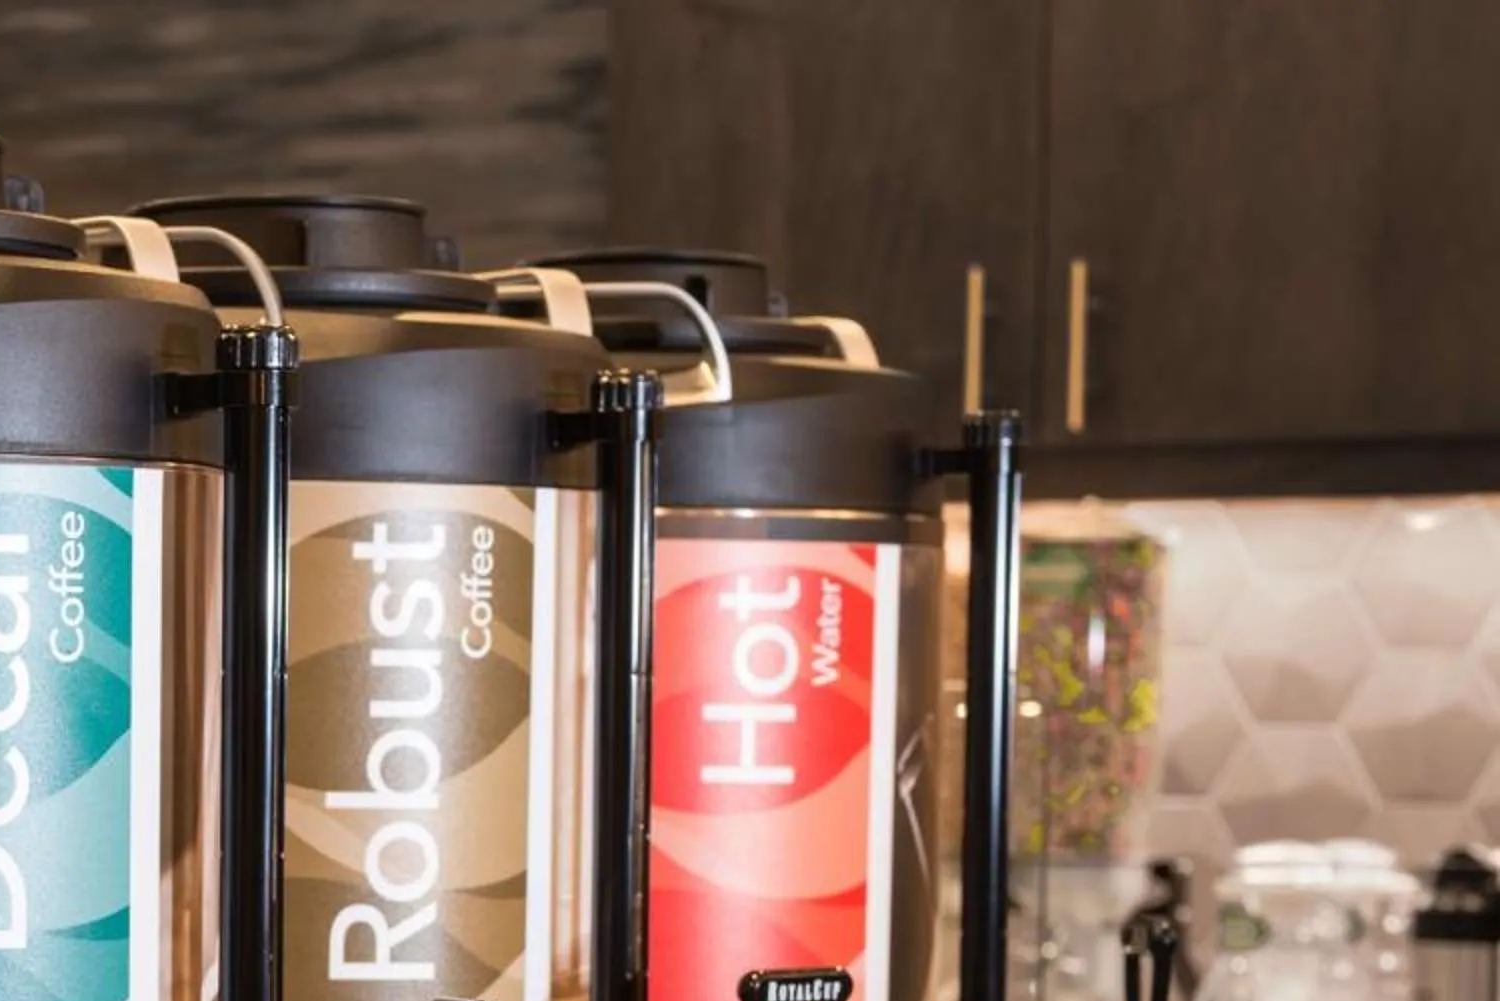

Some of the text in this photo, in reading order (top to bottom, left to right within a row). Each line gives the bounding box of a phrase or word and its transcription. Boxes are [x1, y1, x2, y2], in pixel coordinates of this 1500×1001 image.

[48, 510, 85, 664] Coffee
[461, 524, 496, 660] Coffee
[811, 579, 843, 687] Water
[324, 522, 447, 982] Robust
[700, 575, 801, 785] Hot
